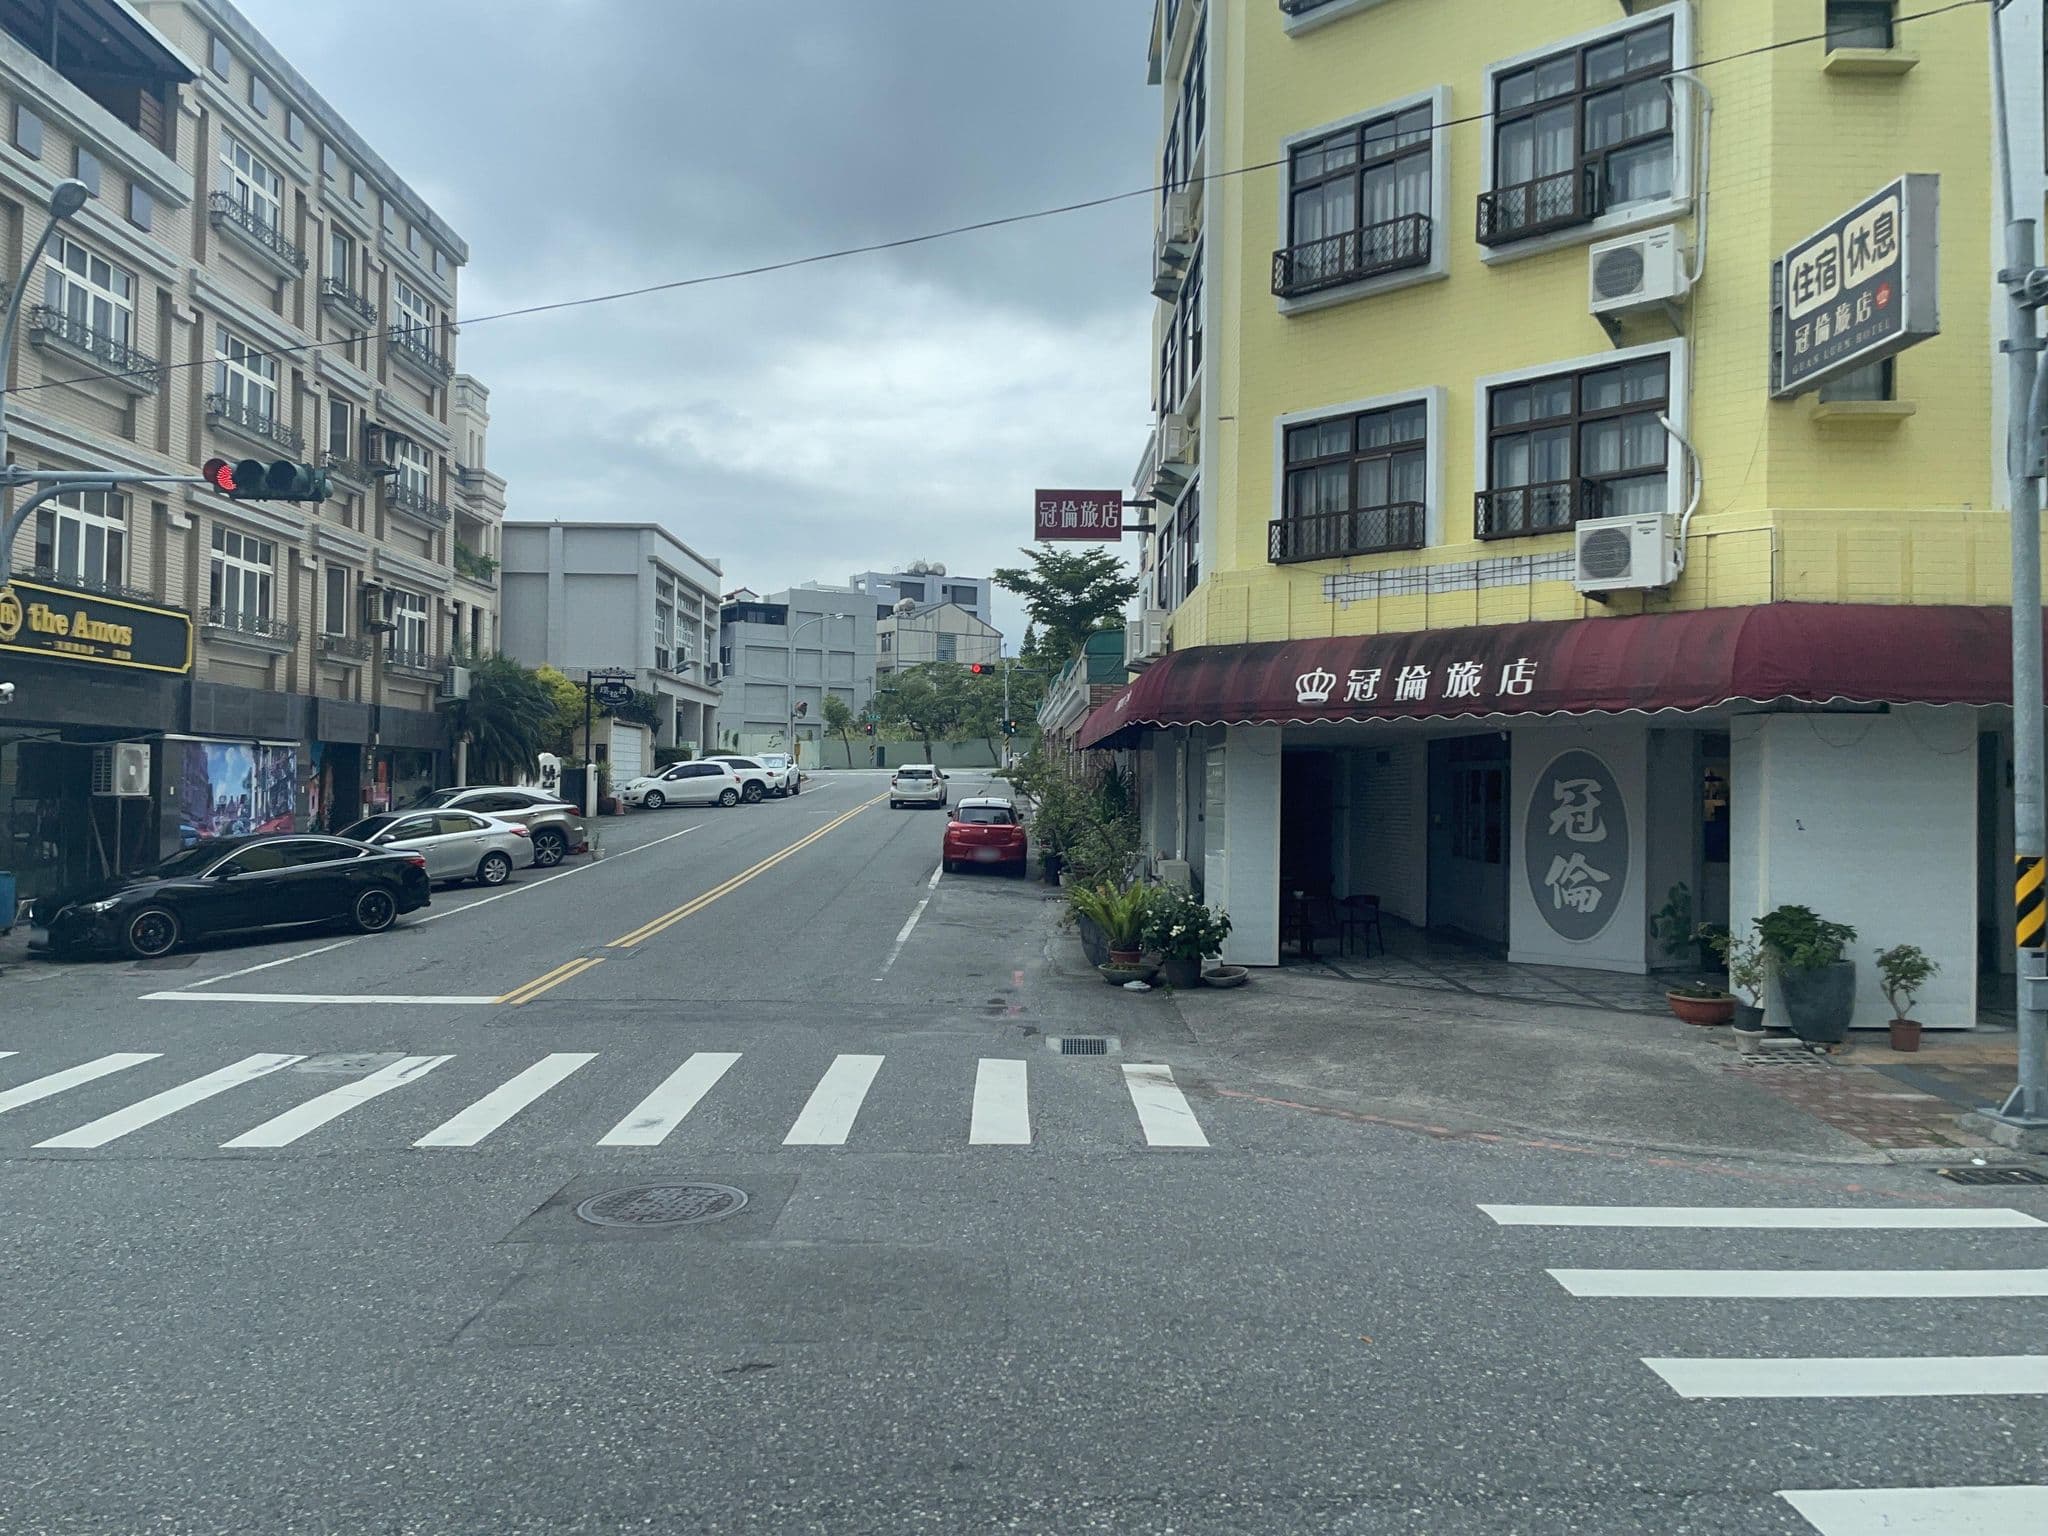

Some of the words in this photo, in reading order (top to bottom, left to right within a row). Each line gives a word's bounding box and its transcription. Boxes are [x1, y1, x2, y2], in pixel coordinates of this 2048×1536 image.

[1792, 246, 1838, 308] 住宿
[1847, 211, 1896, 277] 休息
[1793, 291, 1873, 356] 冠倫旅店
[1039, 500, 1119, 528] 冠倫旅店
[28, 603, 69, 635] the
[72, 611, 133, 646] Amos
[1343, 657, 1538, 702] 冠倫旅店
[1544, 778, 1611, 913] 冠倫
